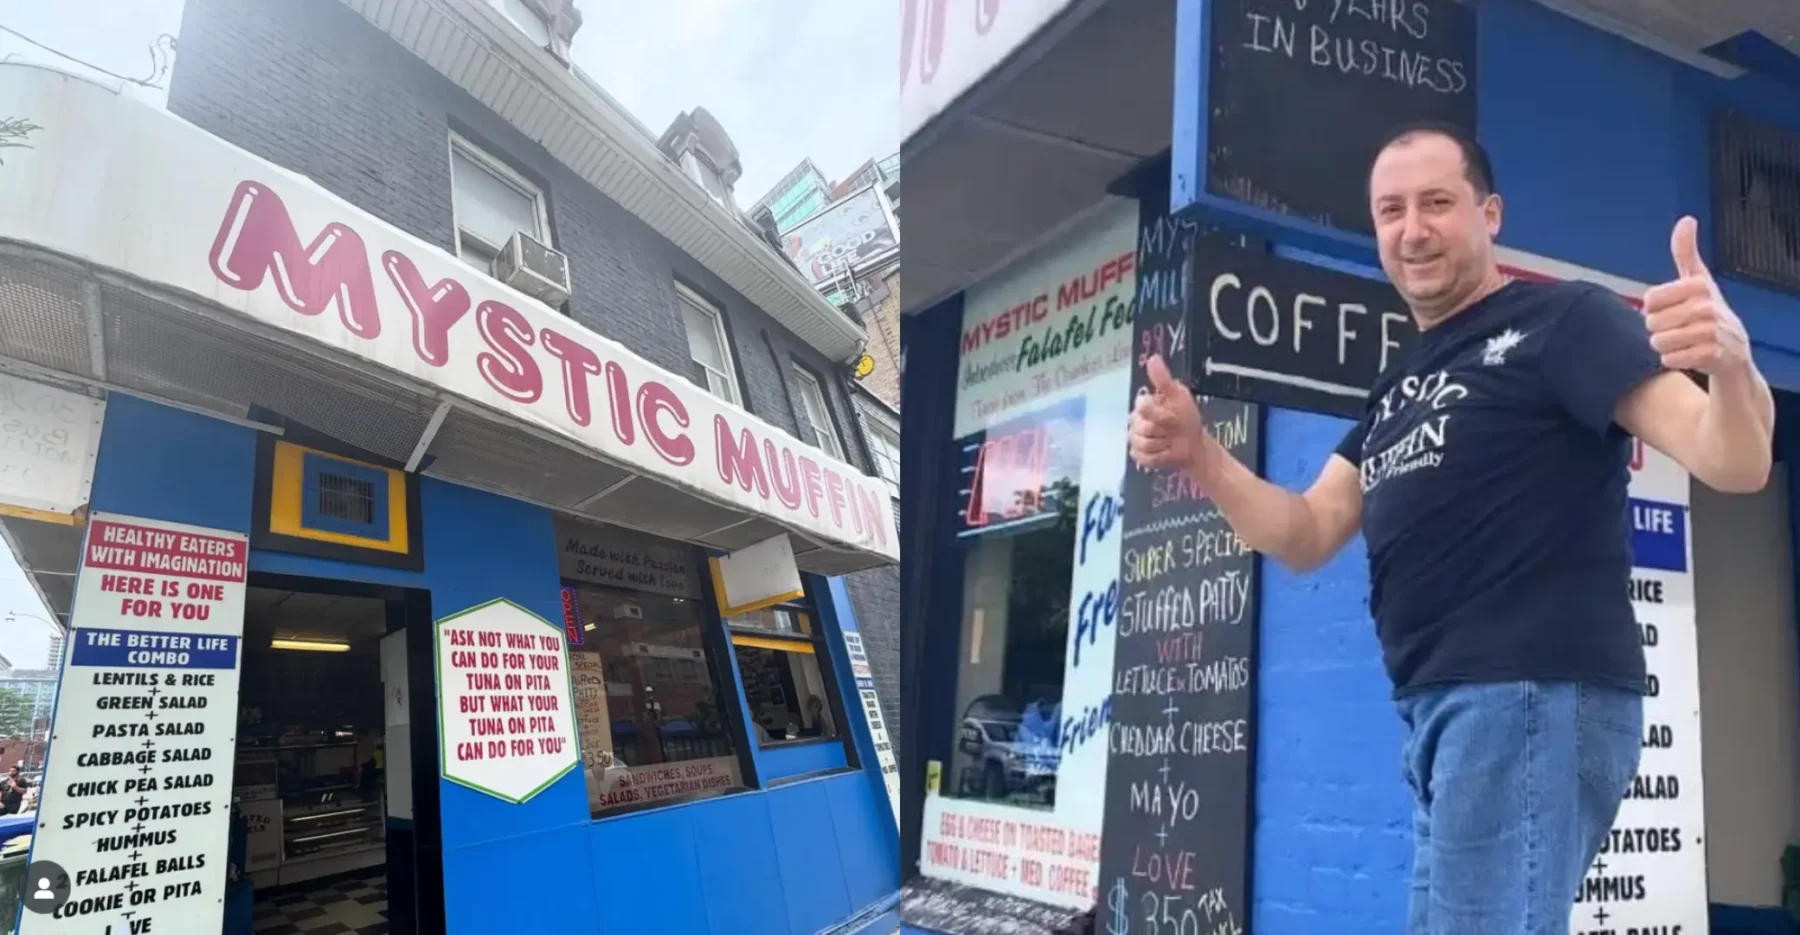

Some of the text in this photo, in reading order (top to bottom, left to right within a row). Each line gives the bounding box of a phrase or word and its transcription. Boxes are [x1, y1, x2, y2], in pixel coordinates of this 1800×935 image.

[1244, 12, 1467, 94] IN BUSINESS
[960, 250, 1134, 356] MYSTIC MUFF
[1016, 304, 1097, 374] Falafel
[208, 179, 696, 467] MYSTIC
[712, 413, 886, 547] MUFFIN
[1633, 506, 1674, 534] LIFE
[104, 526, 235, 558] HEALTHY EATERS
[566, 538, 606, 559] Made
[610, 551, 640, 566] with
[91, 545, 242, 578] WITH IMAGINATION
[576, 559, 625, 580] Served
[628, 571, 656, 586] with
[1125, 541, 1176, 583] SUPER
[101, 575, 224, 601] HERE IS ONE
[120, 599, 210, 621] FOR YOU
[1120, 571, 1249, 638] STUFFED PATTY
[86, 632, 228, 651] THE BETTER LIFE
[444, 629, 560, 652] "ASK NOT WHAT YOU
[1157, 631, 1202, 663] WITH
[127, 651, 190, 666] COMBO
[451, 651, 476, 668] CAN
[481, 652, 498, 669] DO
[502, 653, 526, 669] FOR
[529, 654, 559, 671] YOUR
[93, 673, 215, 686] LENTILS & RICE
[466, 673, 551, 691] TUNA ON PITA
[1115, 665, 1177, 696] LETTUCE
[96, 696, 208, 710] GREEN SALAD
[460, 695, 485, 713] BUT
[489, 695, 524, 712] WHAT
[528, 695, 559, 711] YOUR
[92, 722, 205, 738] PASTA SALAD
[469, 716, 556, 736] TUNA ON PITA
[1061, 698, 1112, 755] Frien
[1180, 719, 1247, 756] CHEESE
[77, 747, 212, 767] CABBAGE SALAD
[457, 737, 567, 761] CAN DO FOR YOU"
[686, 764, 712, 777] SOUPS
[67, 773, 214, 798] CHICK PEA SALAD
[600, 775, 731, 806] SALADS, VEGETARIAN DISHES
[62, 801, 212, 830] SPICY POTATOES
[1130, 781, 1199, 827] MAYO
[96, 830, 177, 853] HUMMUS
[1067, 829, 1100, 862] BAGE
[76, 863, 149, 887] FALAFEL
[156, 853, 206, 876] BALLS
[1048, 864, 1090, 898] COFFEE
[1132, 844, 1197, 890] LOVE
[52, 880, 203, 920] COOKIE OR PITA
